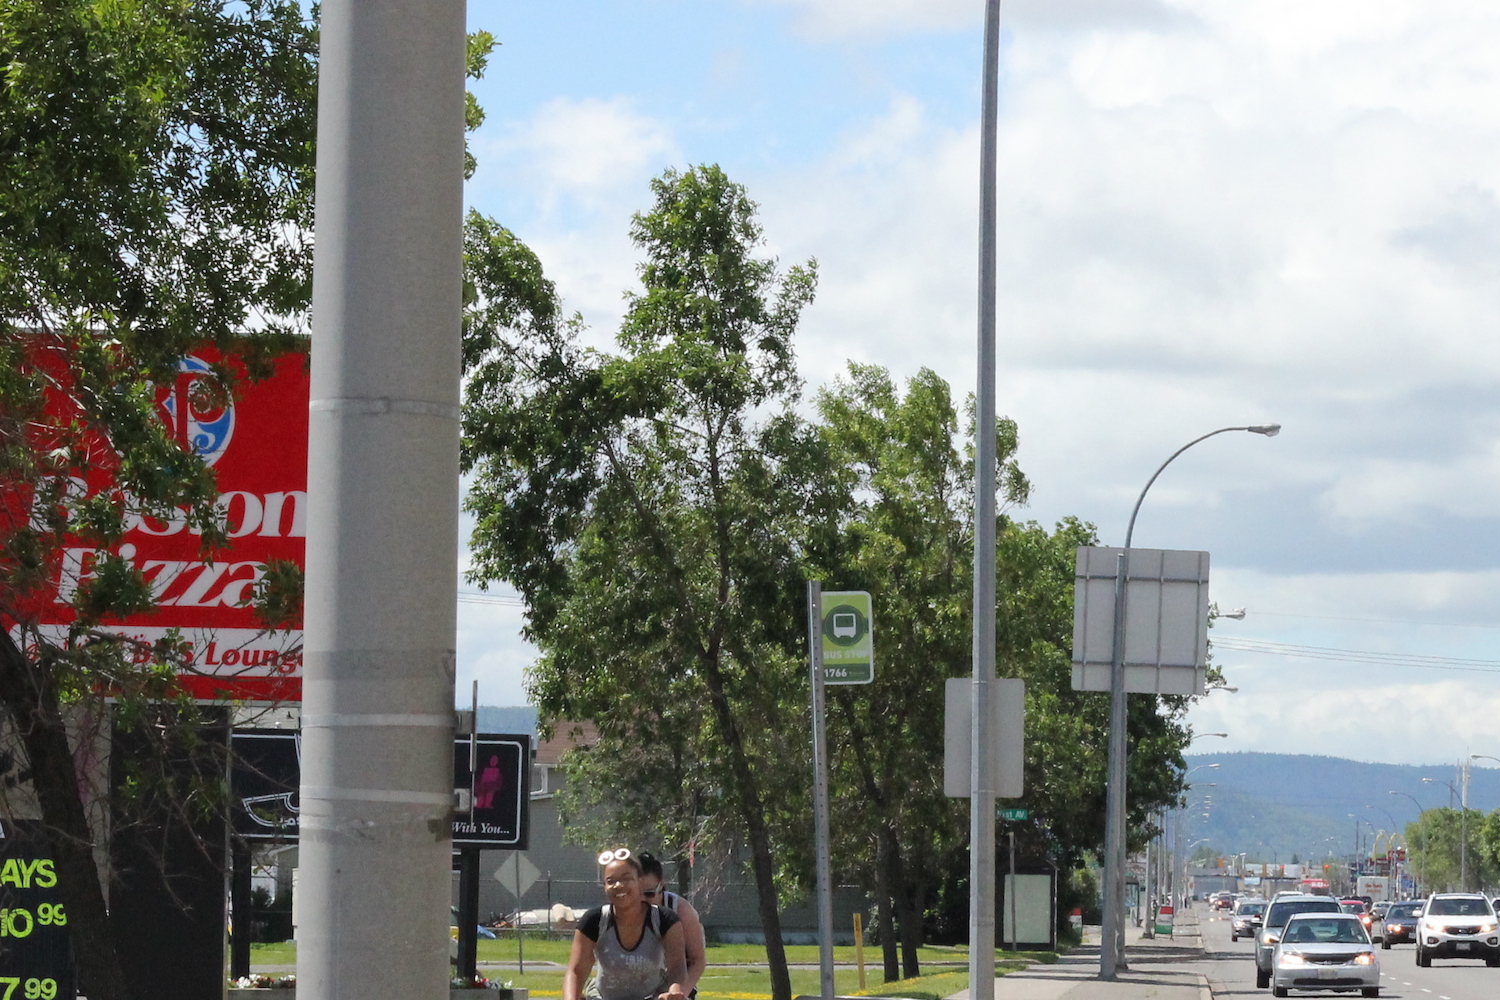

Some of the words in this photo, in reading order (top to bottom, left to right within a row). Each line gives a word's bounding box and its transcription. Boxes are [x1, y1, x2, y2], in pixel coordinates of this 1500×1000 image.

[28, 475, 306, 538] Bson
[823, 650, 842, 659] BUS
[844, 650, 869, 659] STOP
[824, 668, 848, 678] 1766
[452, 821, 477, 833] With
